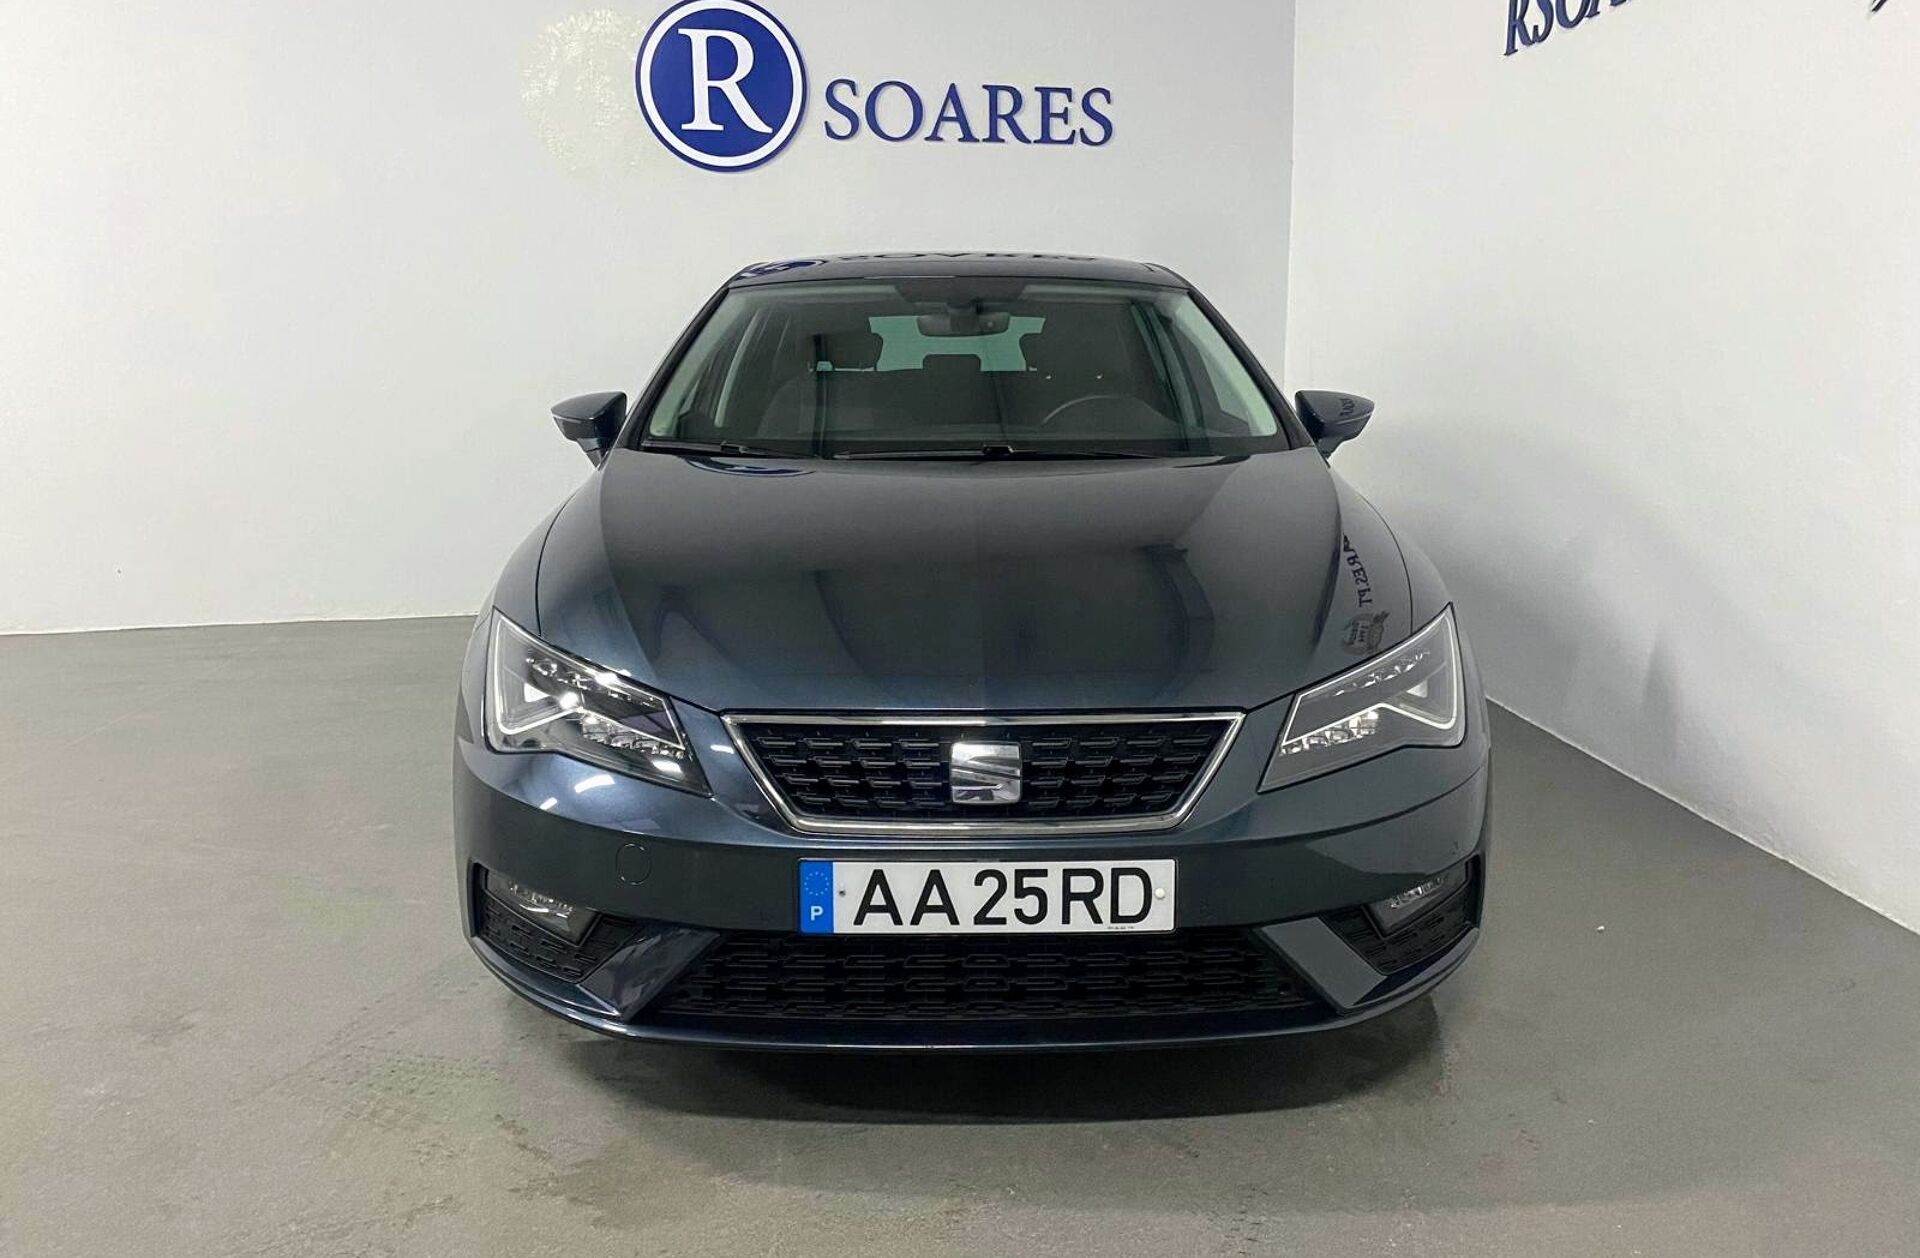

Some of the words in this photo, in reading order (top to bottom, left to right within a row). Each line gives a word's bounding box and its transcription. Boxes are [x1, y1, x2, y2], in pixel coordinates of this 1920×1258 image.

[677, 27, 773, 134] R
[823, 78, 1115, 147] SOARES
[810, 905, 824, 922] P
